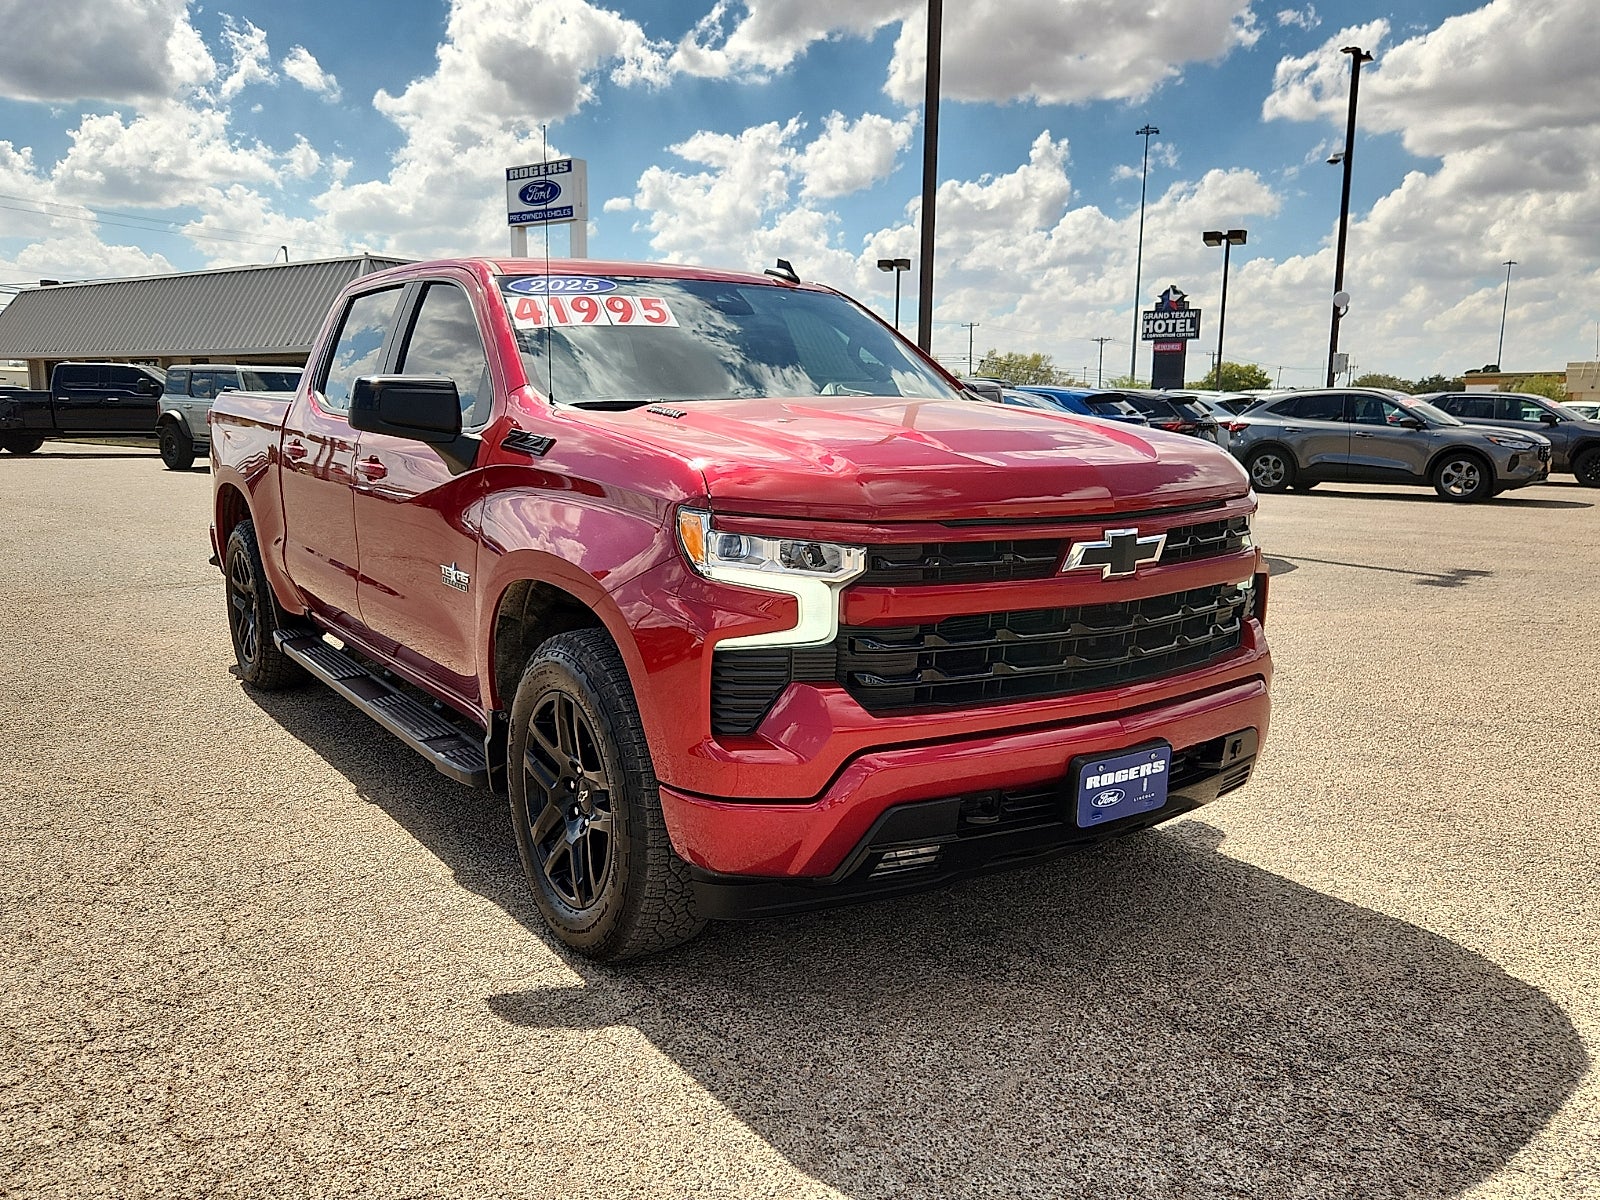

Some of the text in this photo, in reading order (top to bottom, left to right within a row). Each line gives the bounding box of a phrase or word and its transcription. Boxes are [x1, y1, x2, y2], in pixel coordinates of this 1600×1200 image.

[509, 161, 569, 180] ROGERS
[526, 184, 552, 201] Ford
[509, 208, 572, 222] PRE-OWNED VEHICLES
[528, 280, 600, 292] 2025
[514, 296, 670, 325] 41995
[1143, 319, 1195, 333] HOTEL
[440, 562, 470, 584] TEXAS
[1085, 760, 1166, 790] ROGERS
[1098, 791, 1120, 806] Ford
[1133, 792, 1155, 802] LINCOLN
